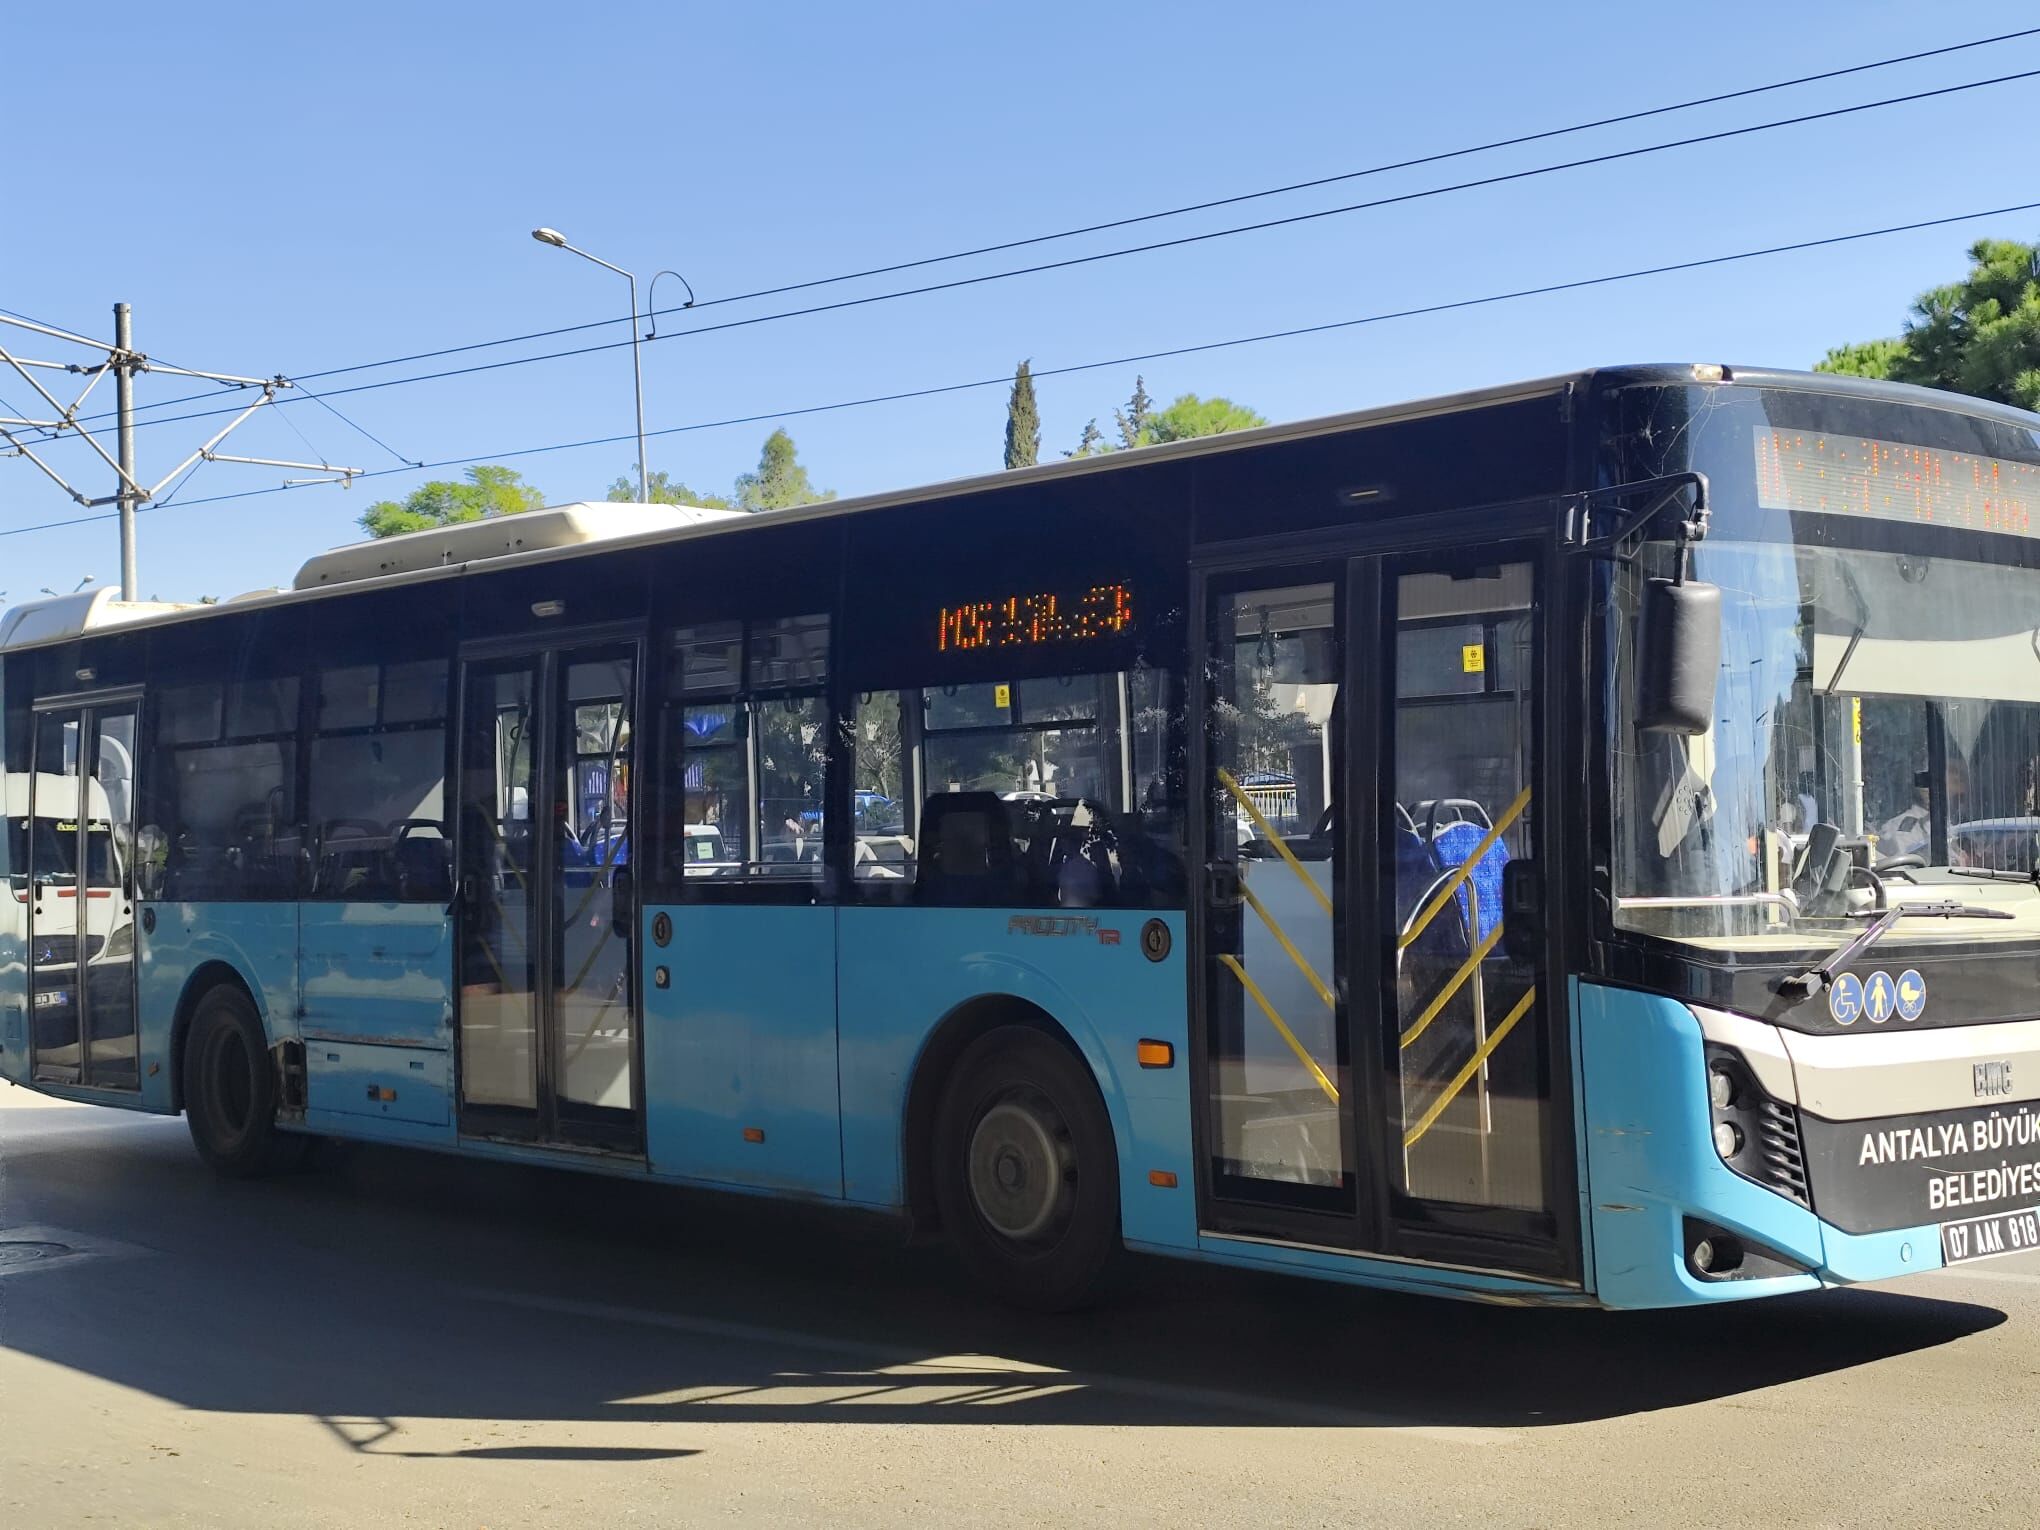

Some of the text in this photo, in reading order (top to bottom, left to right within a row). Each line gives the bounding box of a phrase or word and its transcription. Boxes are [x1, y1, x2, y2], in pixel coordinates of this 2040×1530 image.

[1973, 1061, 2013, 1097] BMC
[1859, 1123, 1969, 1166] ANTALYA
[1949, 1214, 2038, 1259] 07 AAK 818
